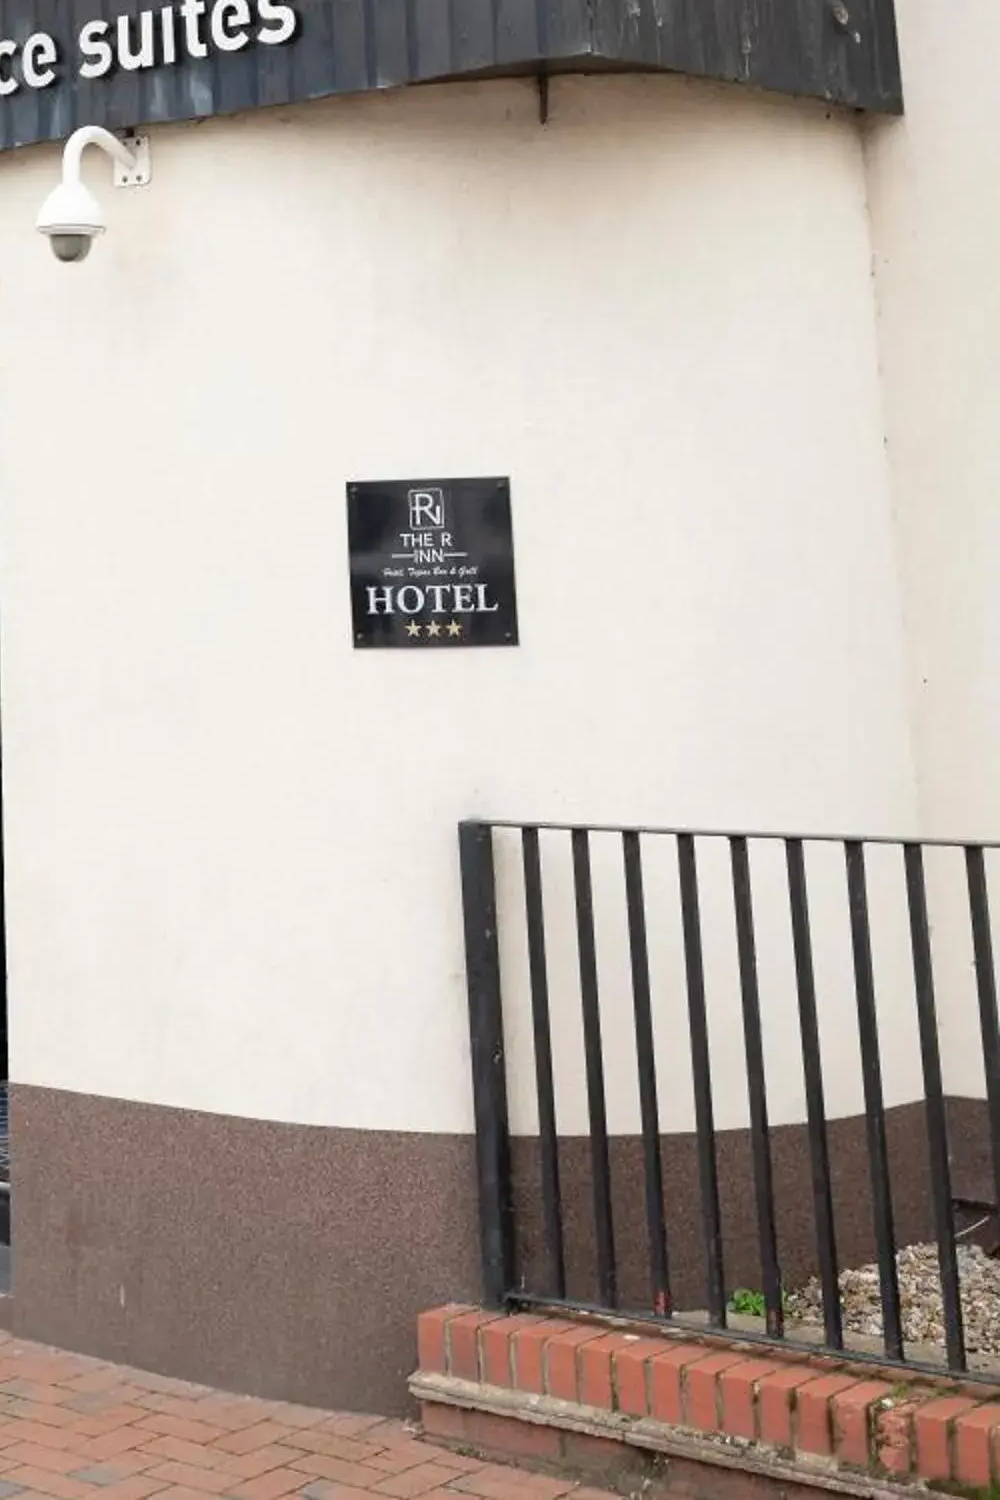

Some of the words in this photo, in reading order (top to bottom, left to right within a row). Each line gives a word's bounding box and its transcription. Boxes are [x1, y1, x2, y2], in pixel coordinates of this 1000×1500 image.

[399, 533, 435, 548] THE
[441, 532, 453, 547] R
[413, 548, 444, 563] INN
[366, 584, 499, 615] HOTEL
